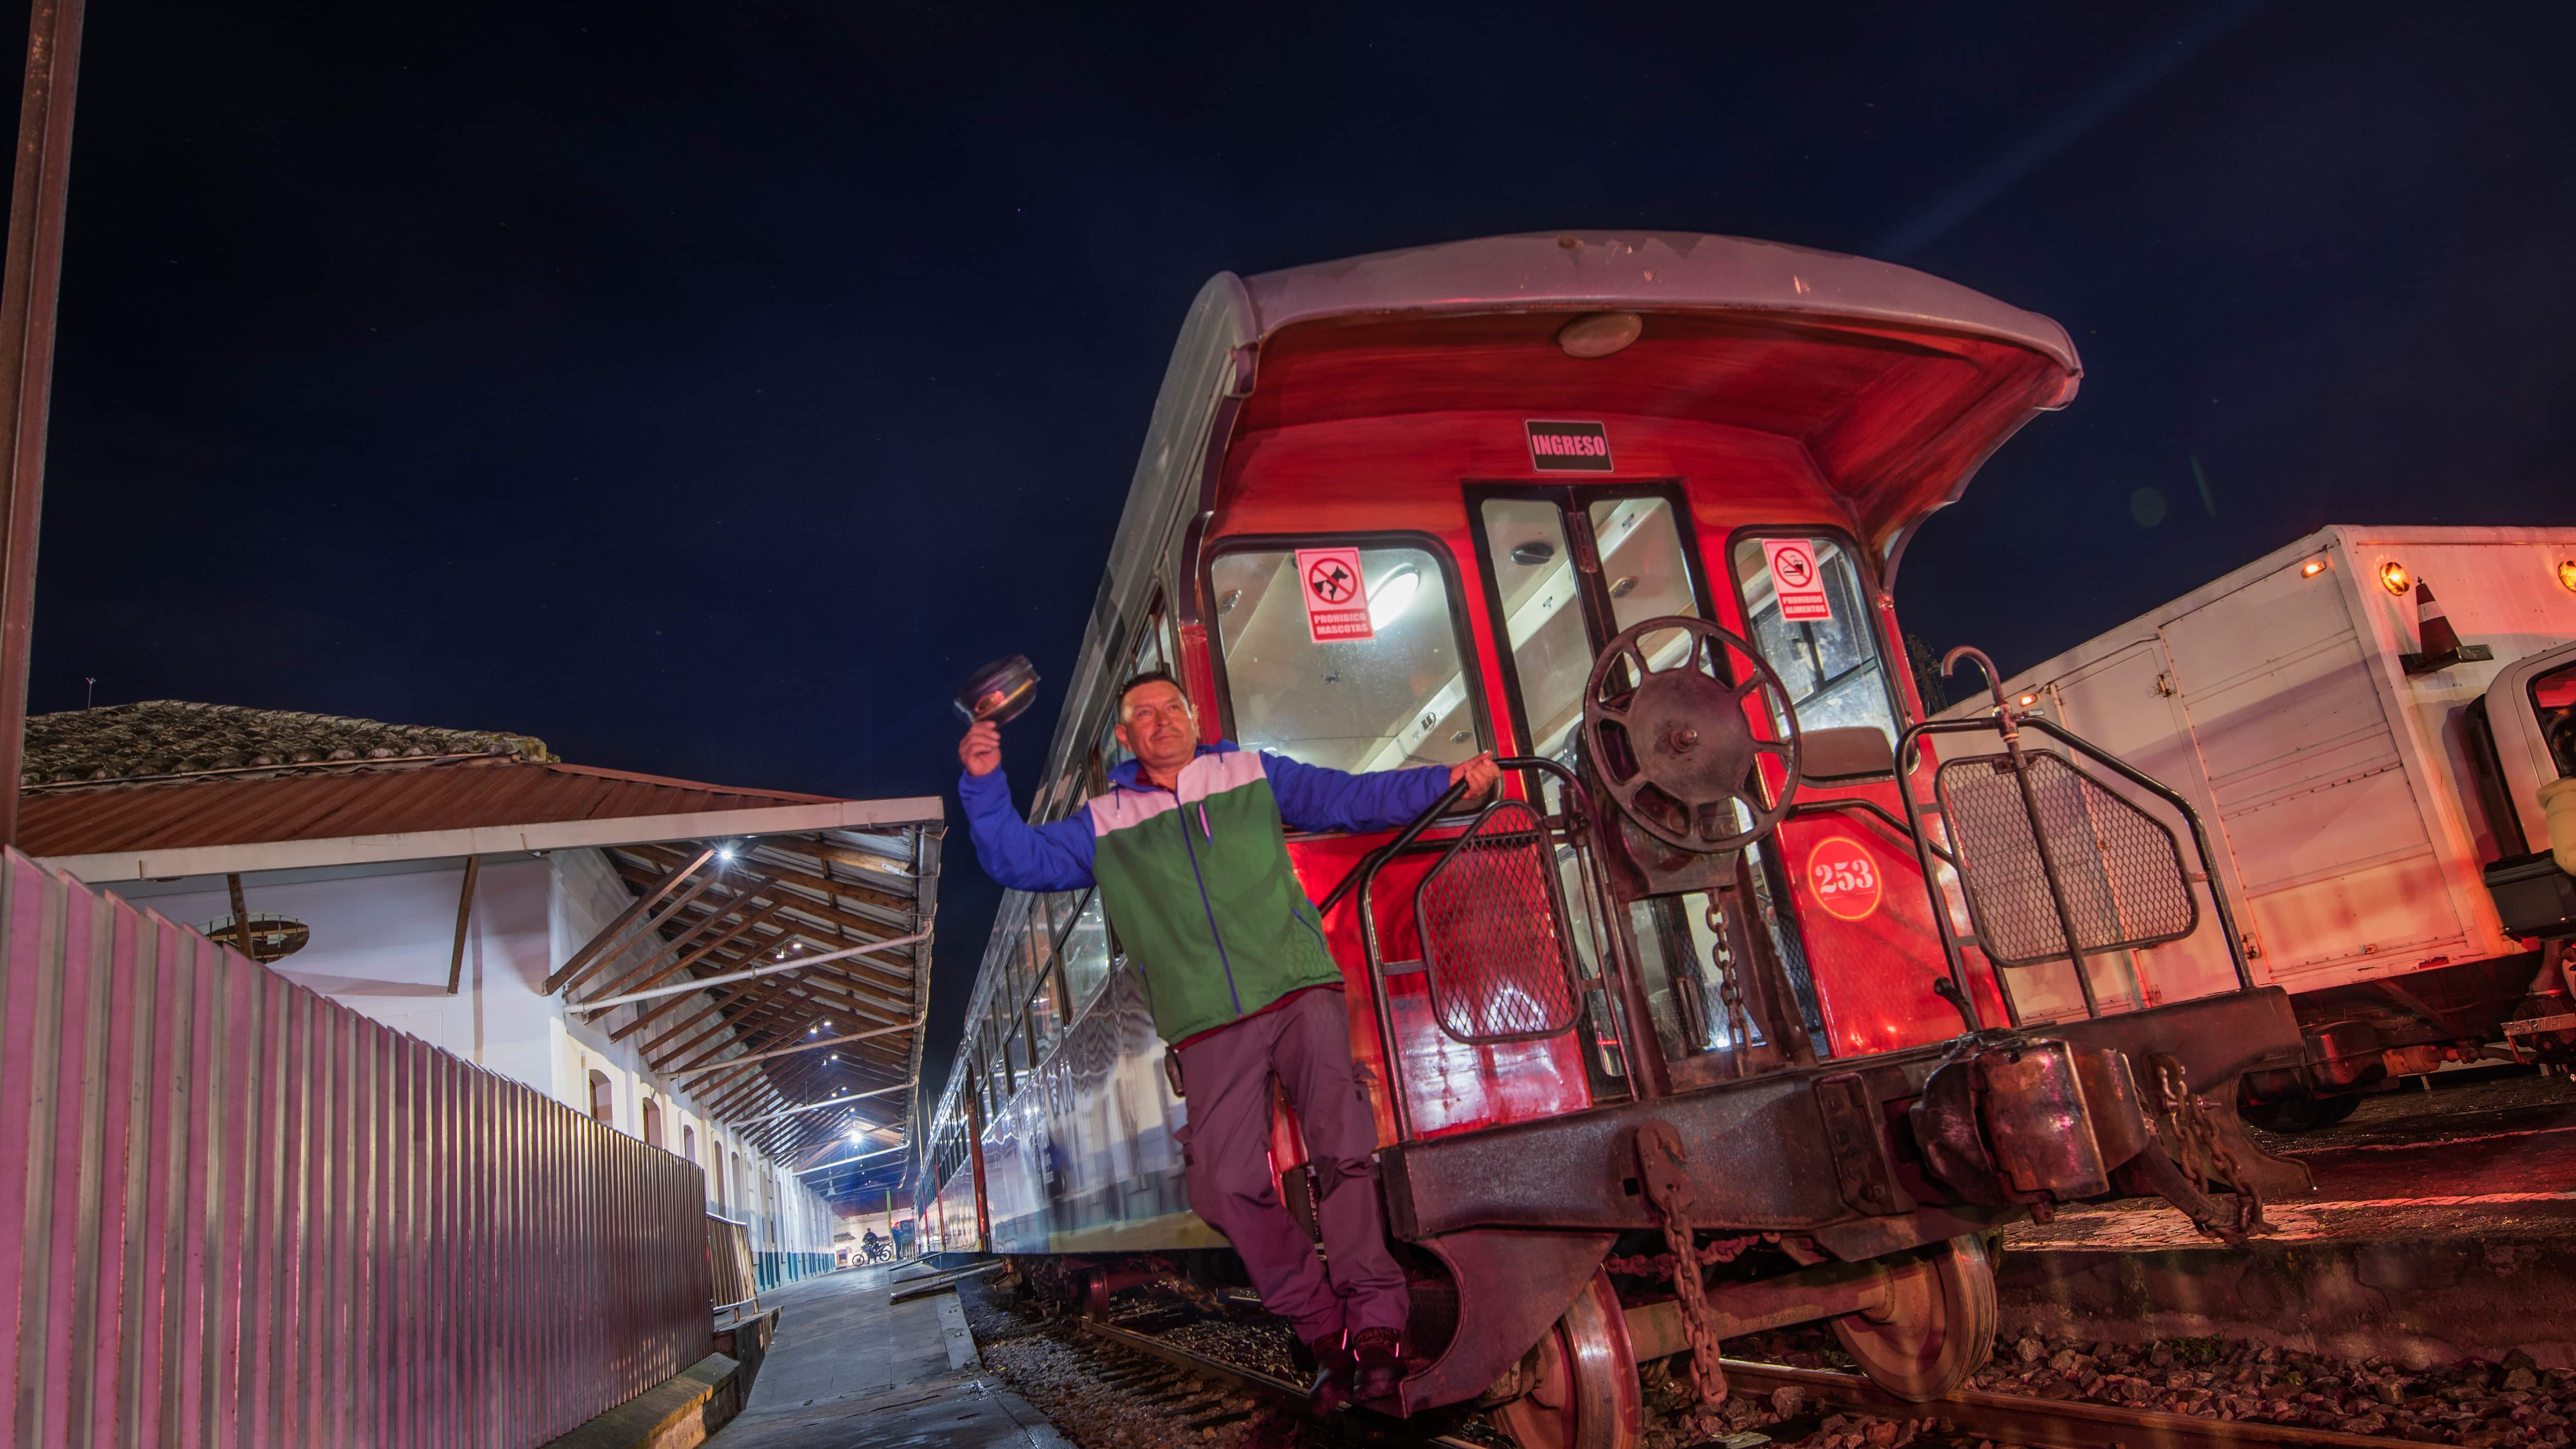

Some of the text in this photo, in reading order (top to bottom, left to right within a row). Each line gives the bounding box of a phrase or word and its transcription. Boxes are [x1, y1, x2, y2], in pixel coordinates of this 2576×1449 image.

[1532, 434, 1606, 457] INGRESO
[1782, 595, 1823, 604] PROHIBIDO
[1785, 605, 1826, 614] ALIMENTOS
[1314, 613, 1365, 624] PROHIBIDO
[1316, 624, 1368, 634] MASCOTAS
[1815, 860, 1873, 894] 253
